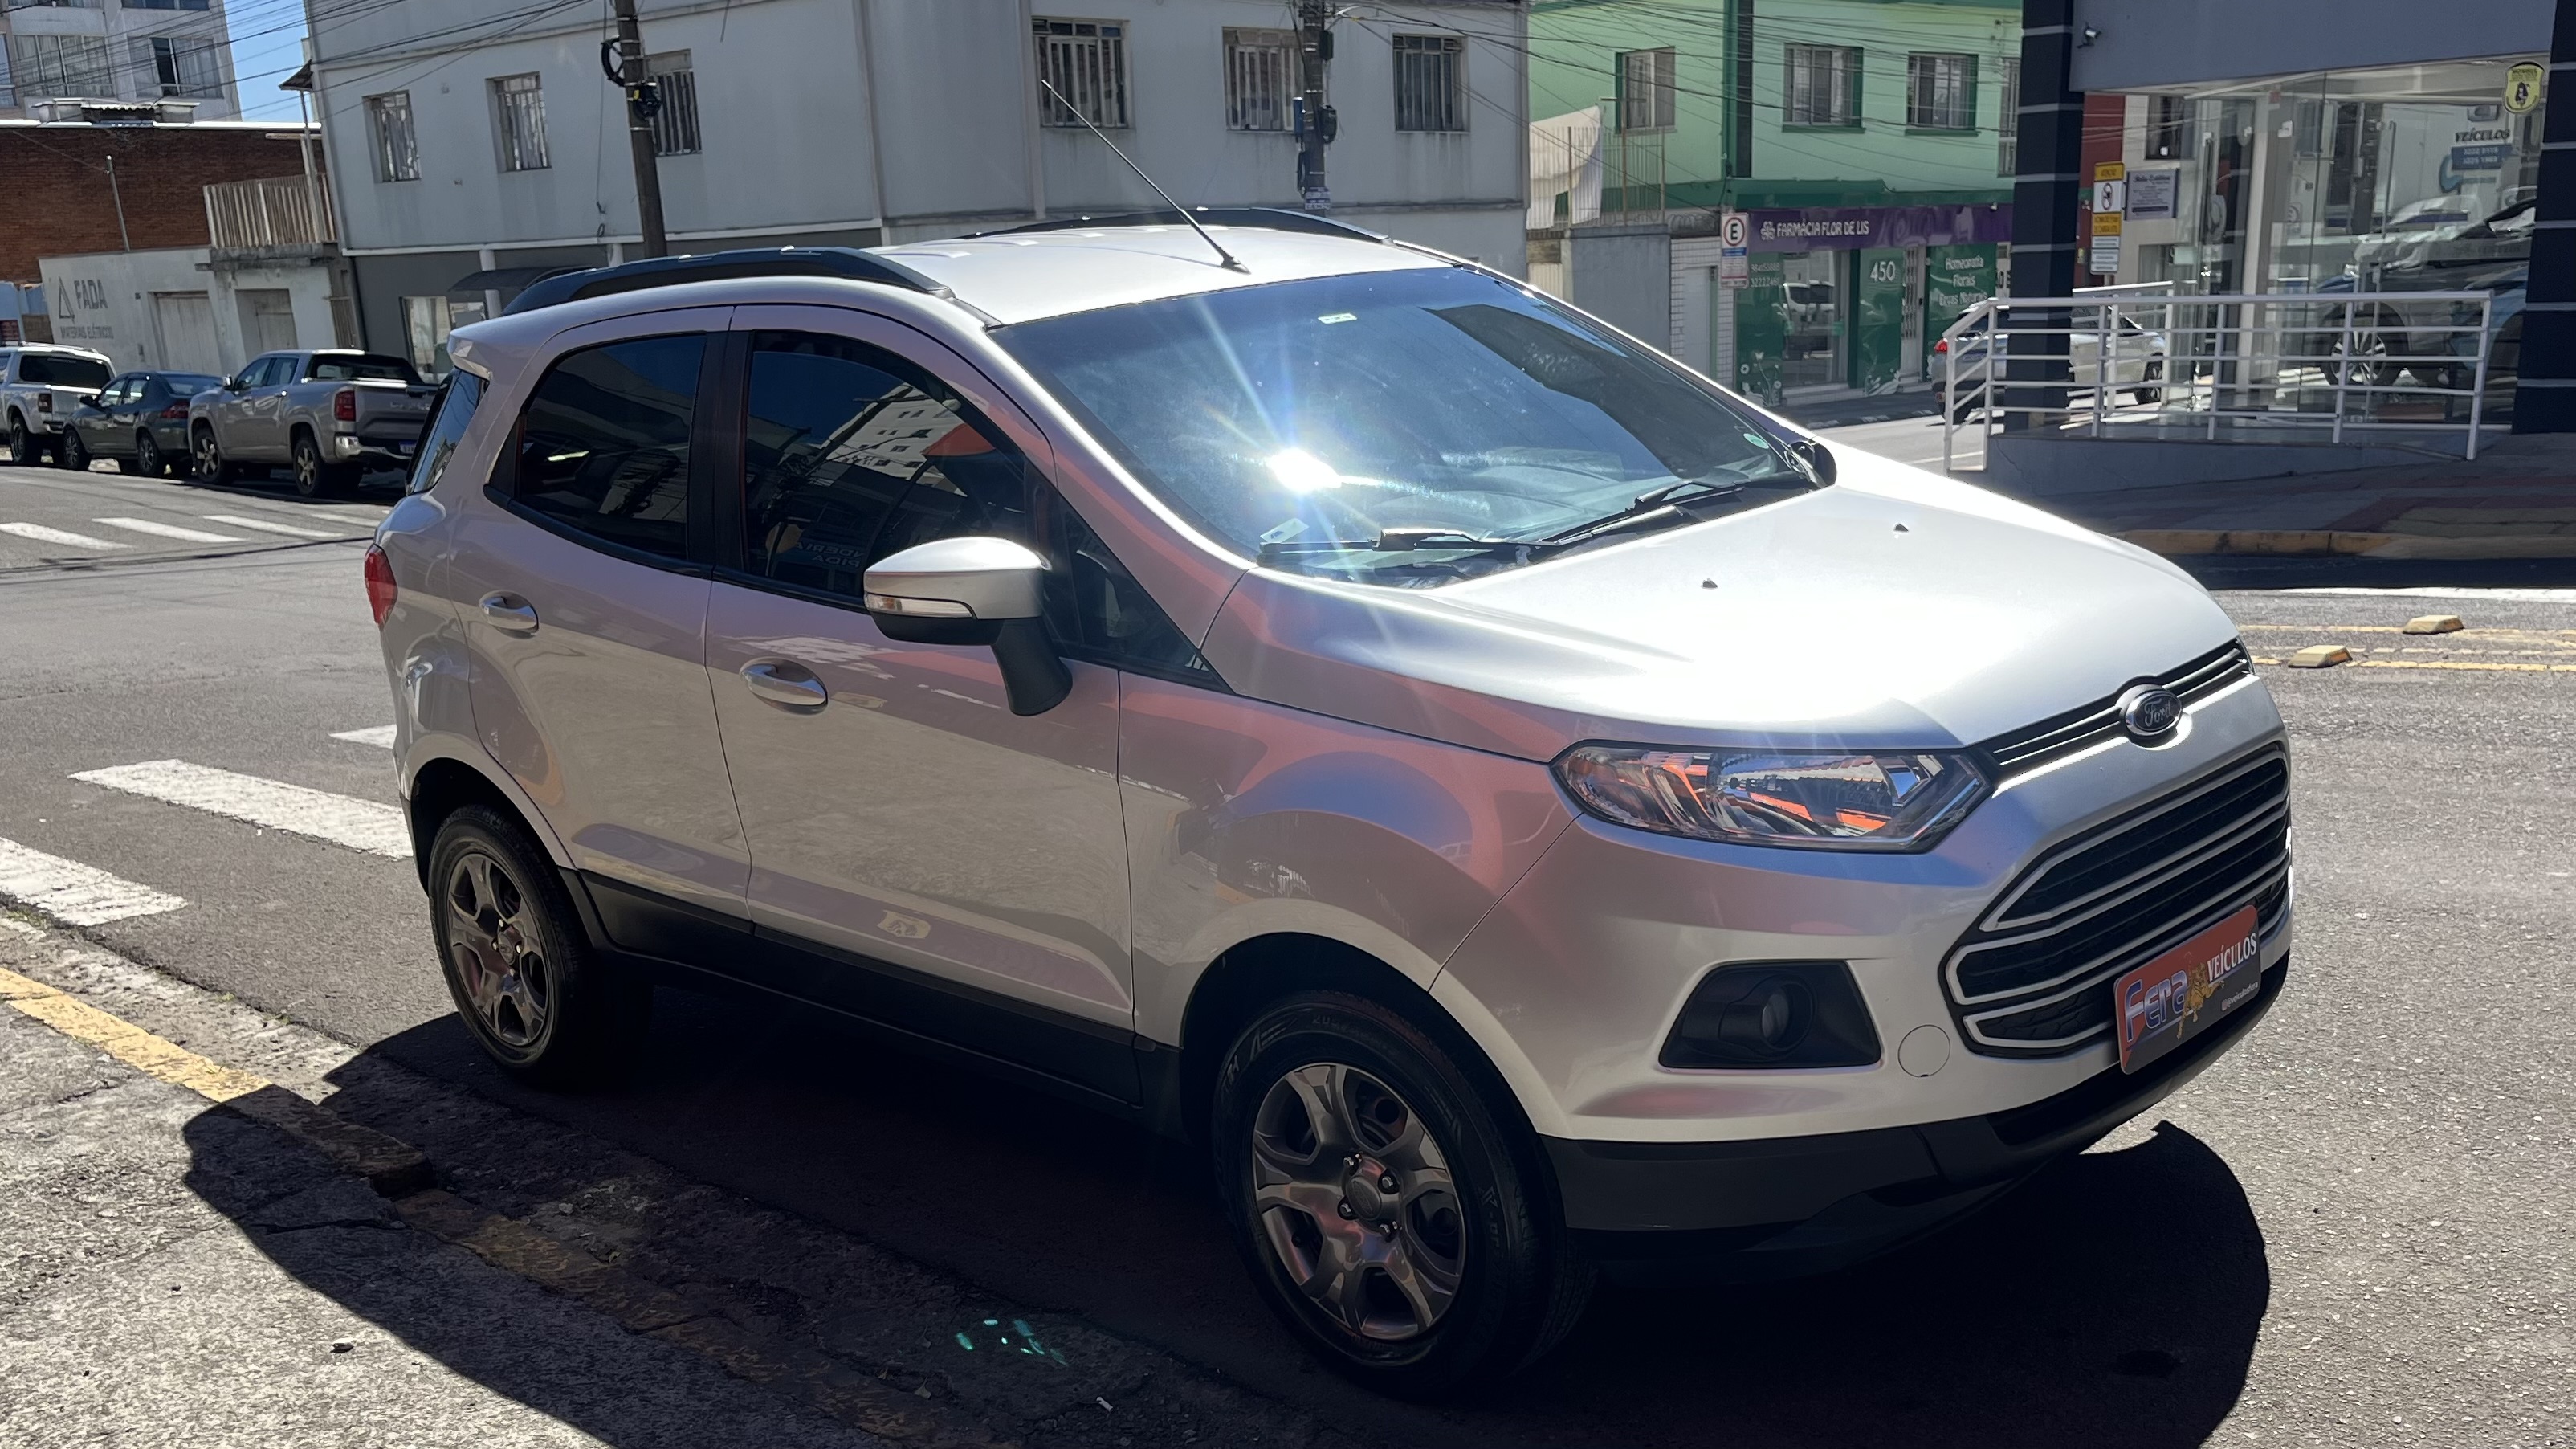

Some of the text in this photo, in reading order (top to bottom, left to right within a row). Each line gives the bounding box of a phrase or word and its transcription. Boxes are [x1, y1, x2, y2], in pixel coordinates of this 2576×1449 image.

[1730, 223, 1738, 240] E
[1776, 218, 1869, 238] FARMÁCIA FLOR DE LIS
[1869, 260, 1896, 282] 450
[74, 279, 108, 310] FADA
[2143, 697, 2173, 728] Ford
[2124, 933, 2257, 1043] Fera VEÍCULOS
